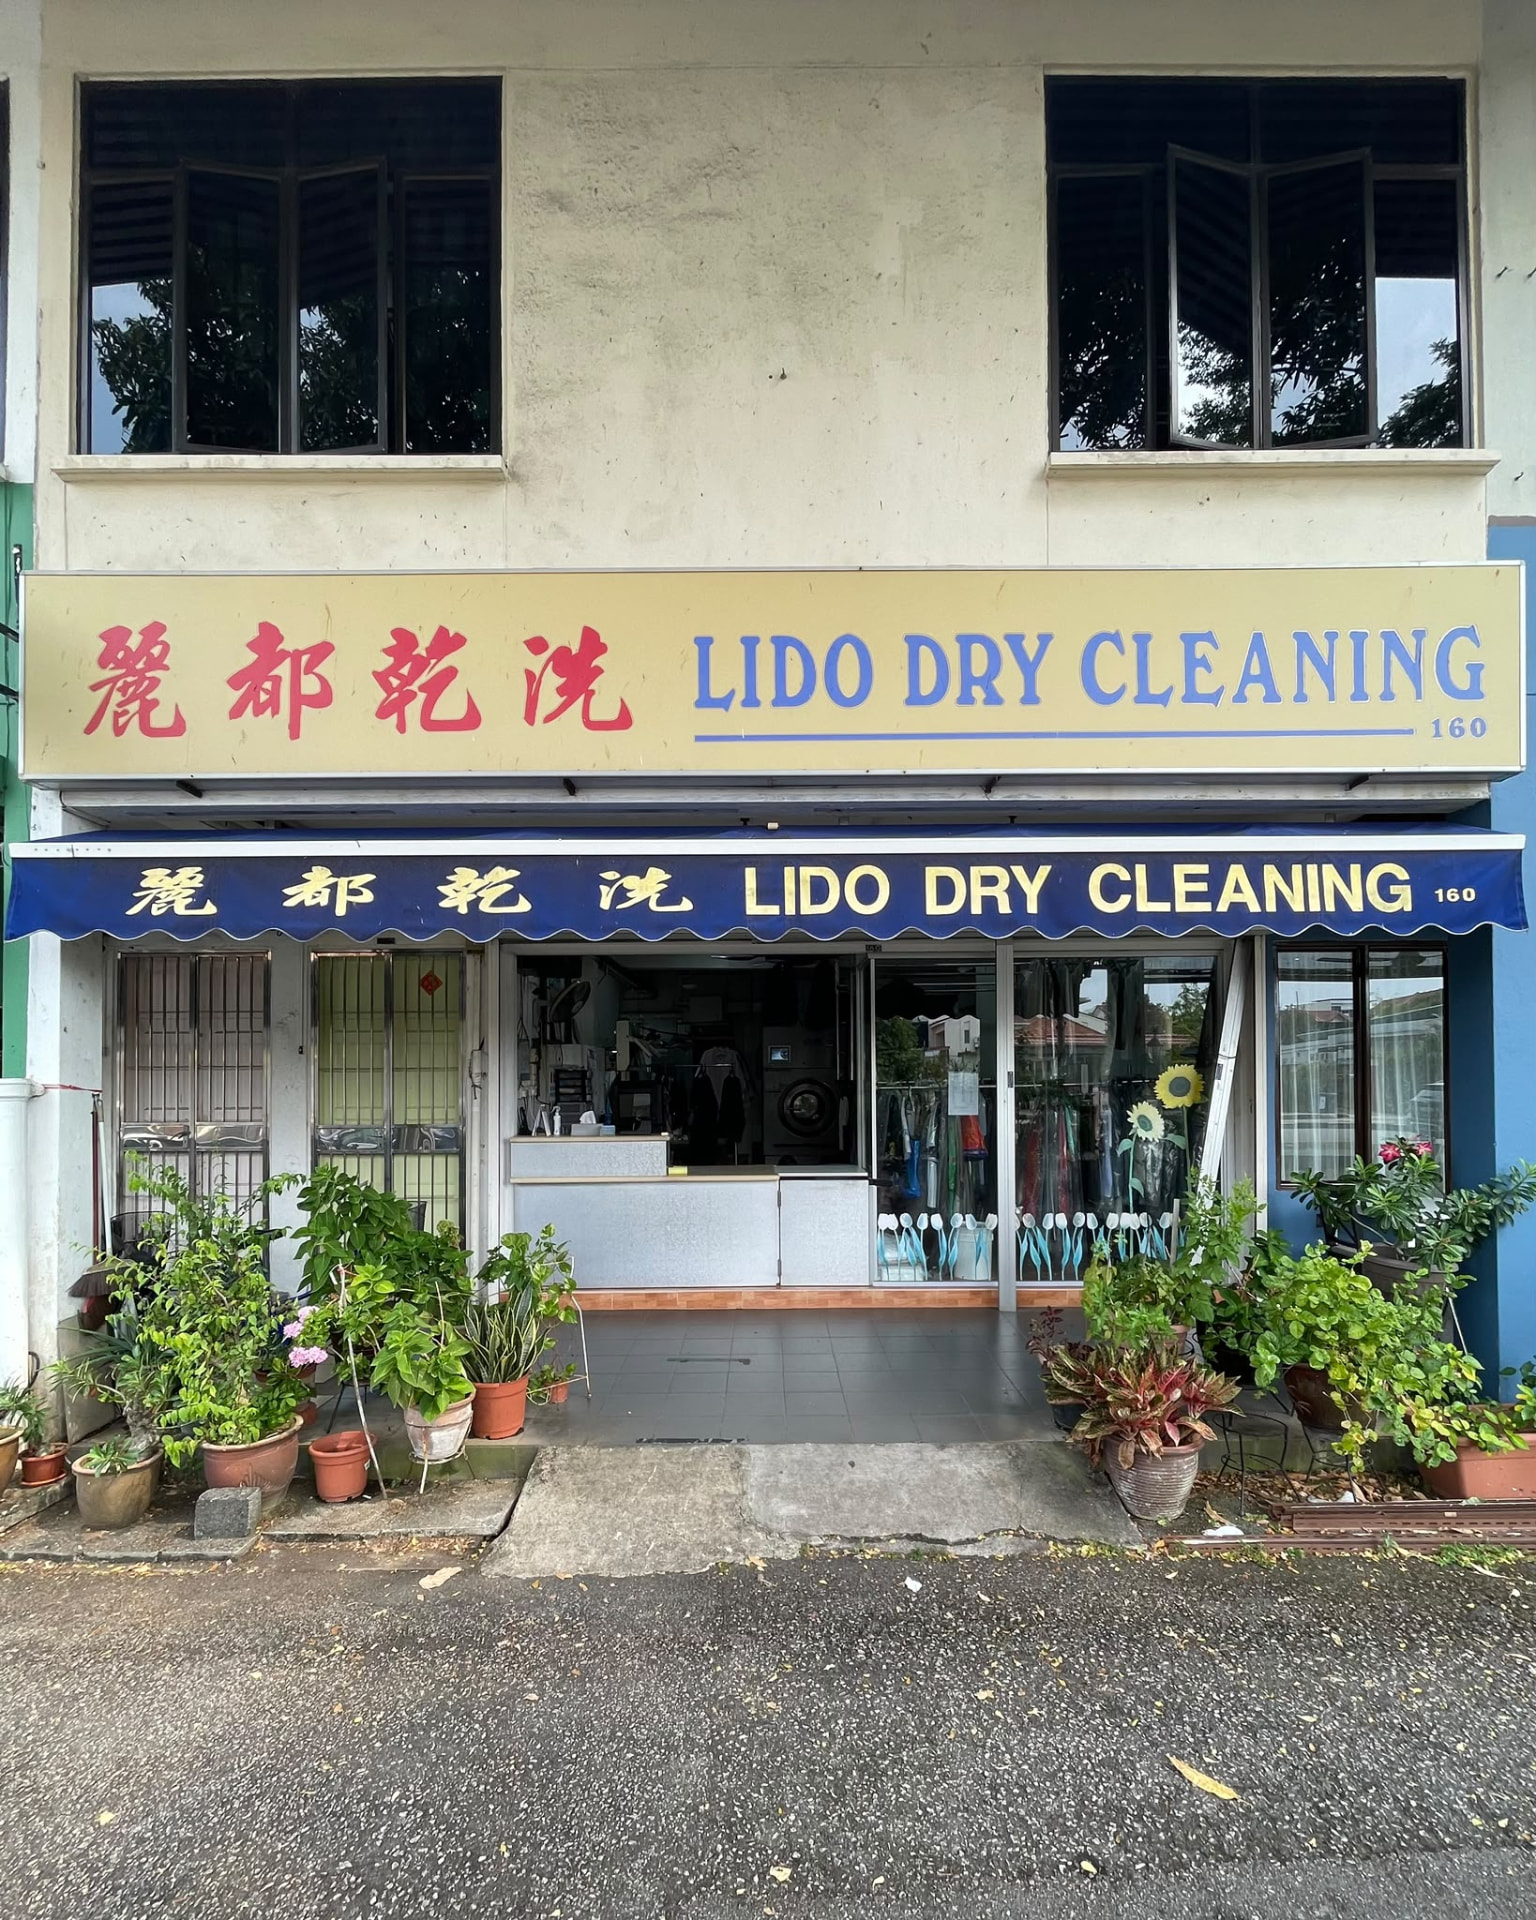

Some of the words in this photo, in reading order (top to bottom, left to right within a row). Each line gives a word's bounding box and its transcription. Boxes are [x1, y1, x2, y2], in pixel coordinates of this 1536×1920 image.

[84, 621, 633, 740] 麗都乾洗
[694, 634, 873, 711] LIDO
[904, 634, 1053, 706] DRY
[1081, 625, 1485, 706] CLEANING
[1432, 717, 1487, 738] 160
[126, 865, 692, 916] 麗都乾洗
[746, 865, 890, 916] LIDO
[925, 865, 1051, 915] DRY
[1088, 862, 1412, 913] CLEANING
[1434, 887, 1476, 904] 160
